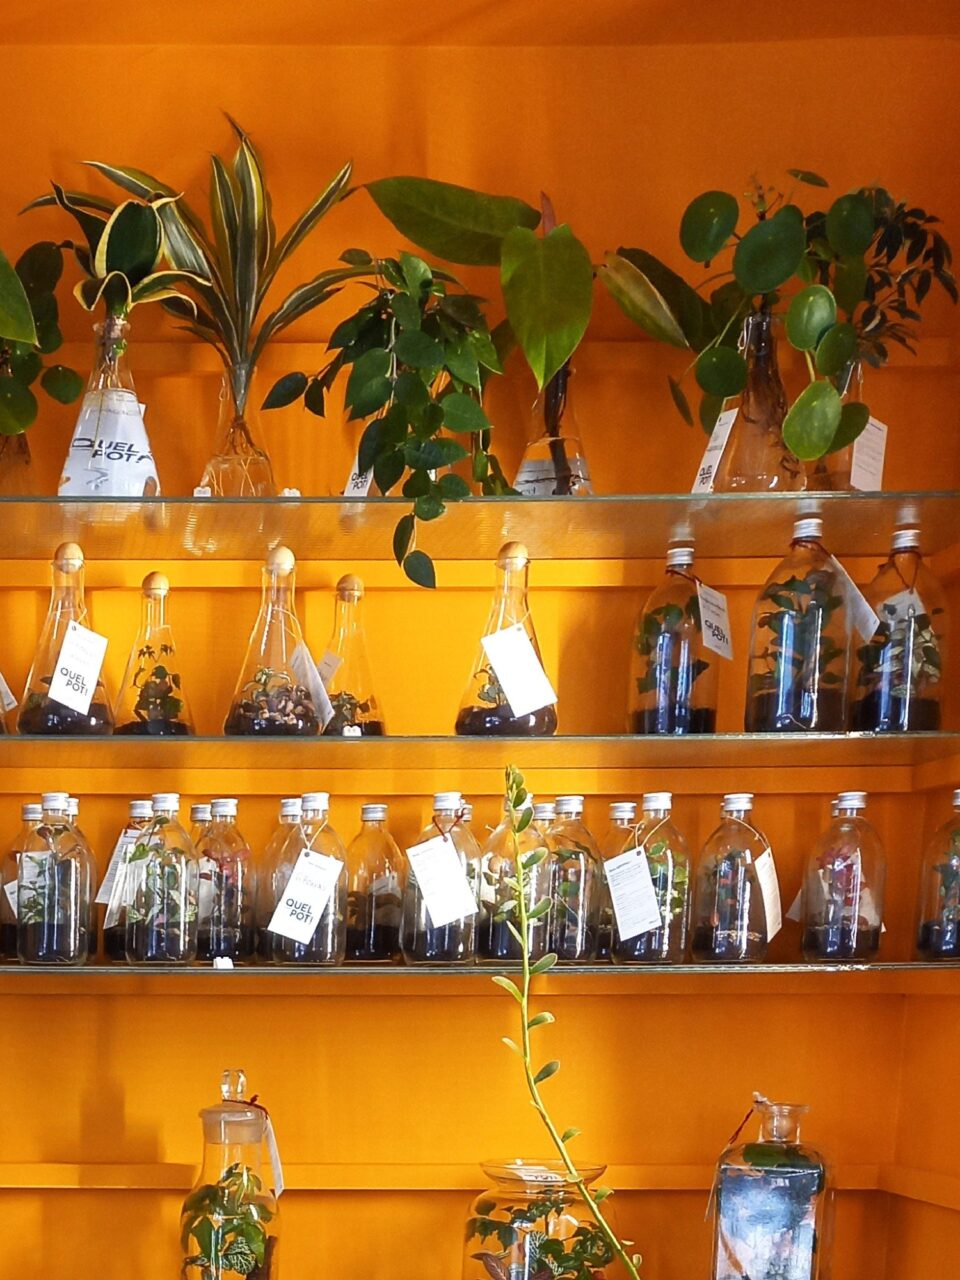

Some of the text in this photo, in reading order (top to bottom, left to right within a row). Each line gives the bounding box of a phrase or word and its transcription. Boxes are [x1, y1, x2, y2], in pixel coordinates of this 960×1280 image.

[60, 667, 86, 687] QUEL
[65, 679, 88, 697] POT!
[285, 898, 313, 915] QUEL
[289, 909, 314, 925] POT!
